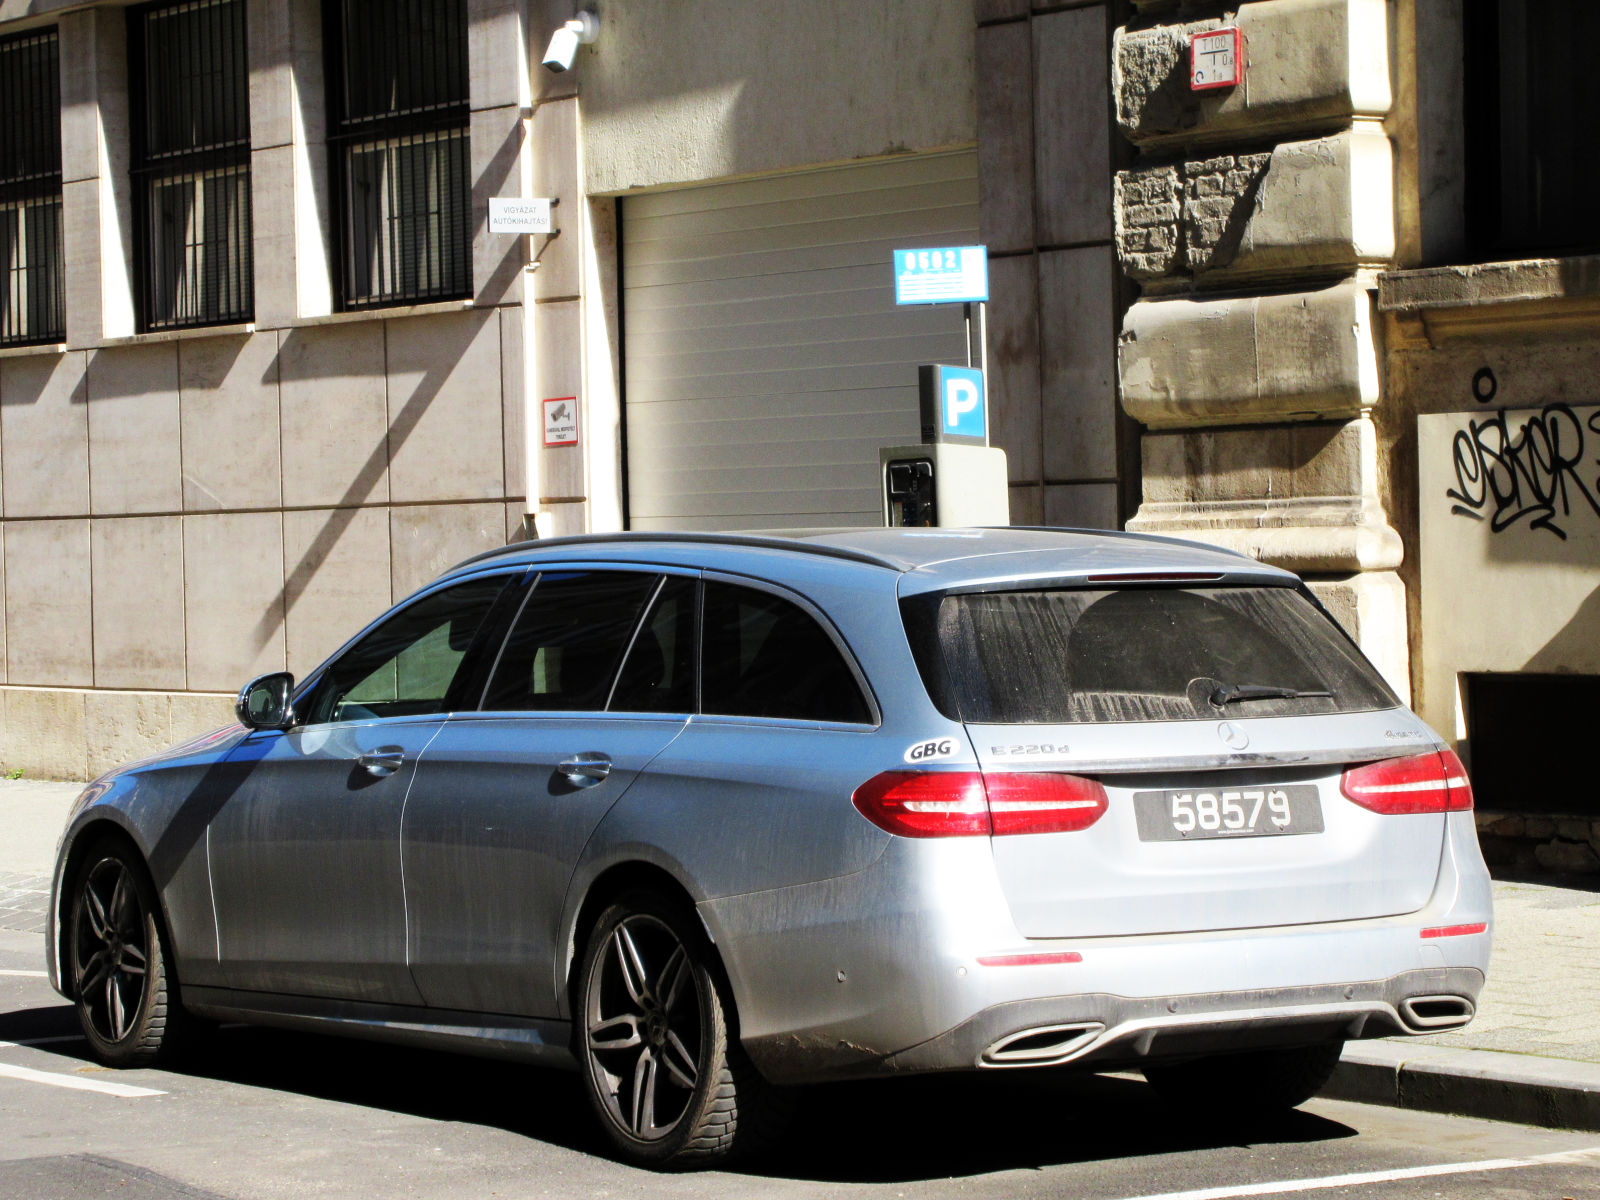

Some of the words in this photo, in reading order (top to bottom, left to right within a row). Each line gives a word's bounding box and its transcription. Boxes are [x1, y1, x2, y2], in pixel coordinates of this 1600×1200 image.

[503, 205, 537, 214] VIGYÁZAT
[905, 251, 957, 271] 0502
[946, 378, 978, 427] P
[910, 740, 951, 760] GBG
[1172, 790, 1291, 832] 58579
